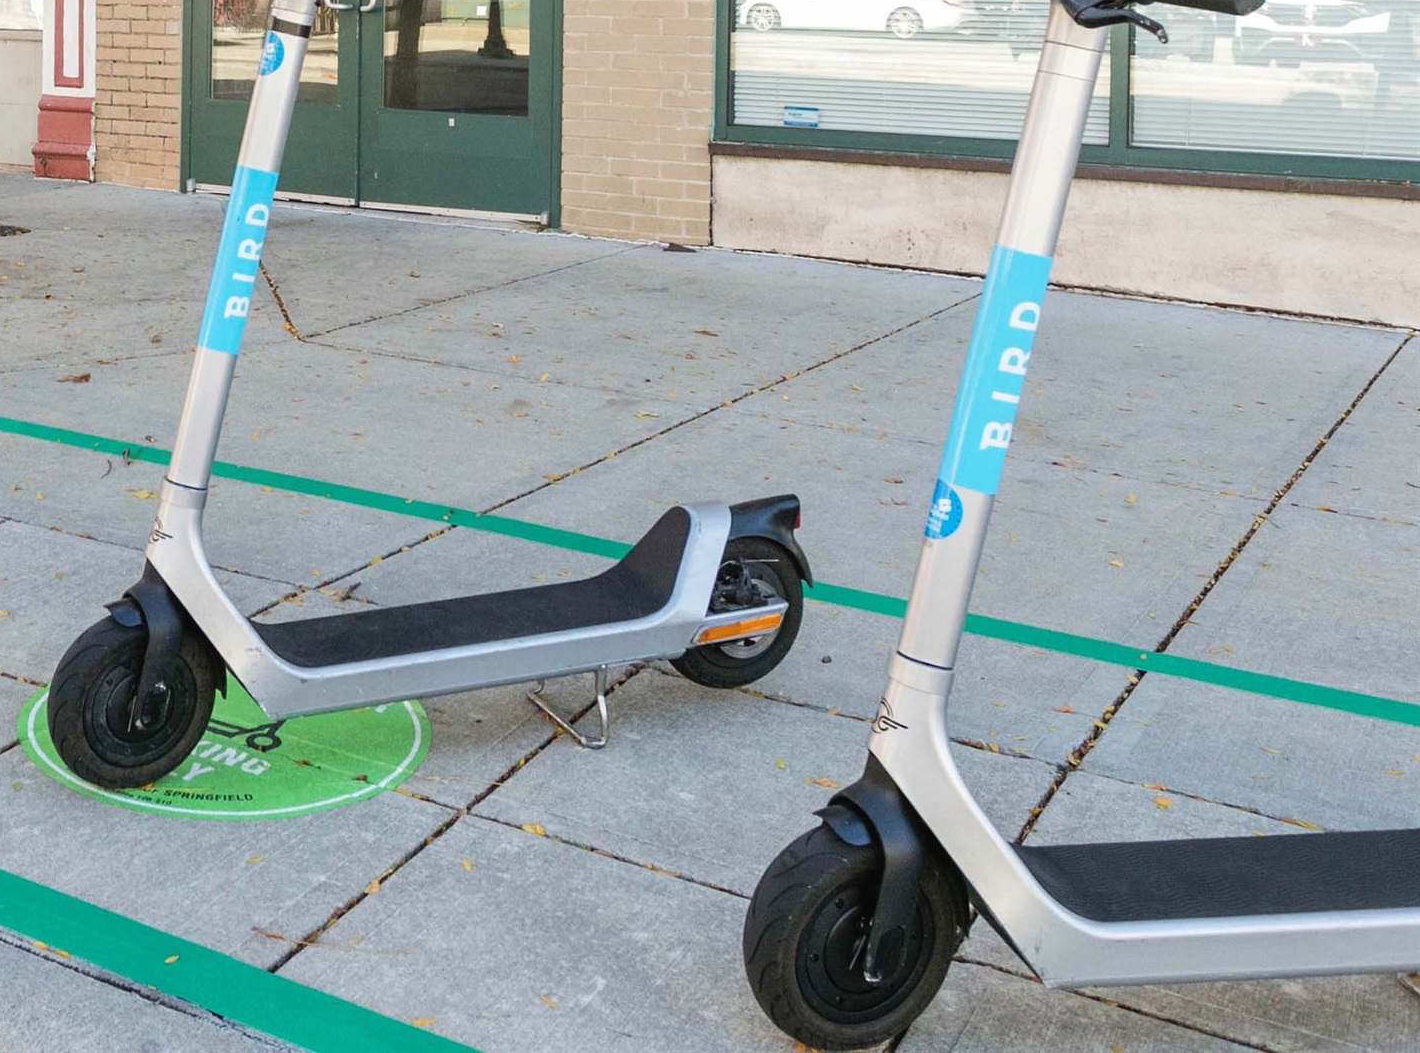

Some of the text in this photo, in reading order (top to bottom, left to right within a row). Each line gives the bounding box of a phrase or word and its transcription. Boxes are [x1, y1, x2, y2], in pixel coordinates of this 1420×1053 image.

[223, 202, 270, 319] BIRD
[979, 300, 1042, 451] BIRD
[163, 789, 254, 802] SPRINGFIELD
